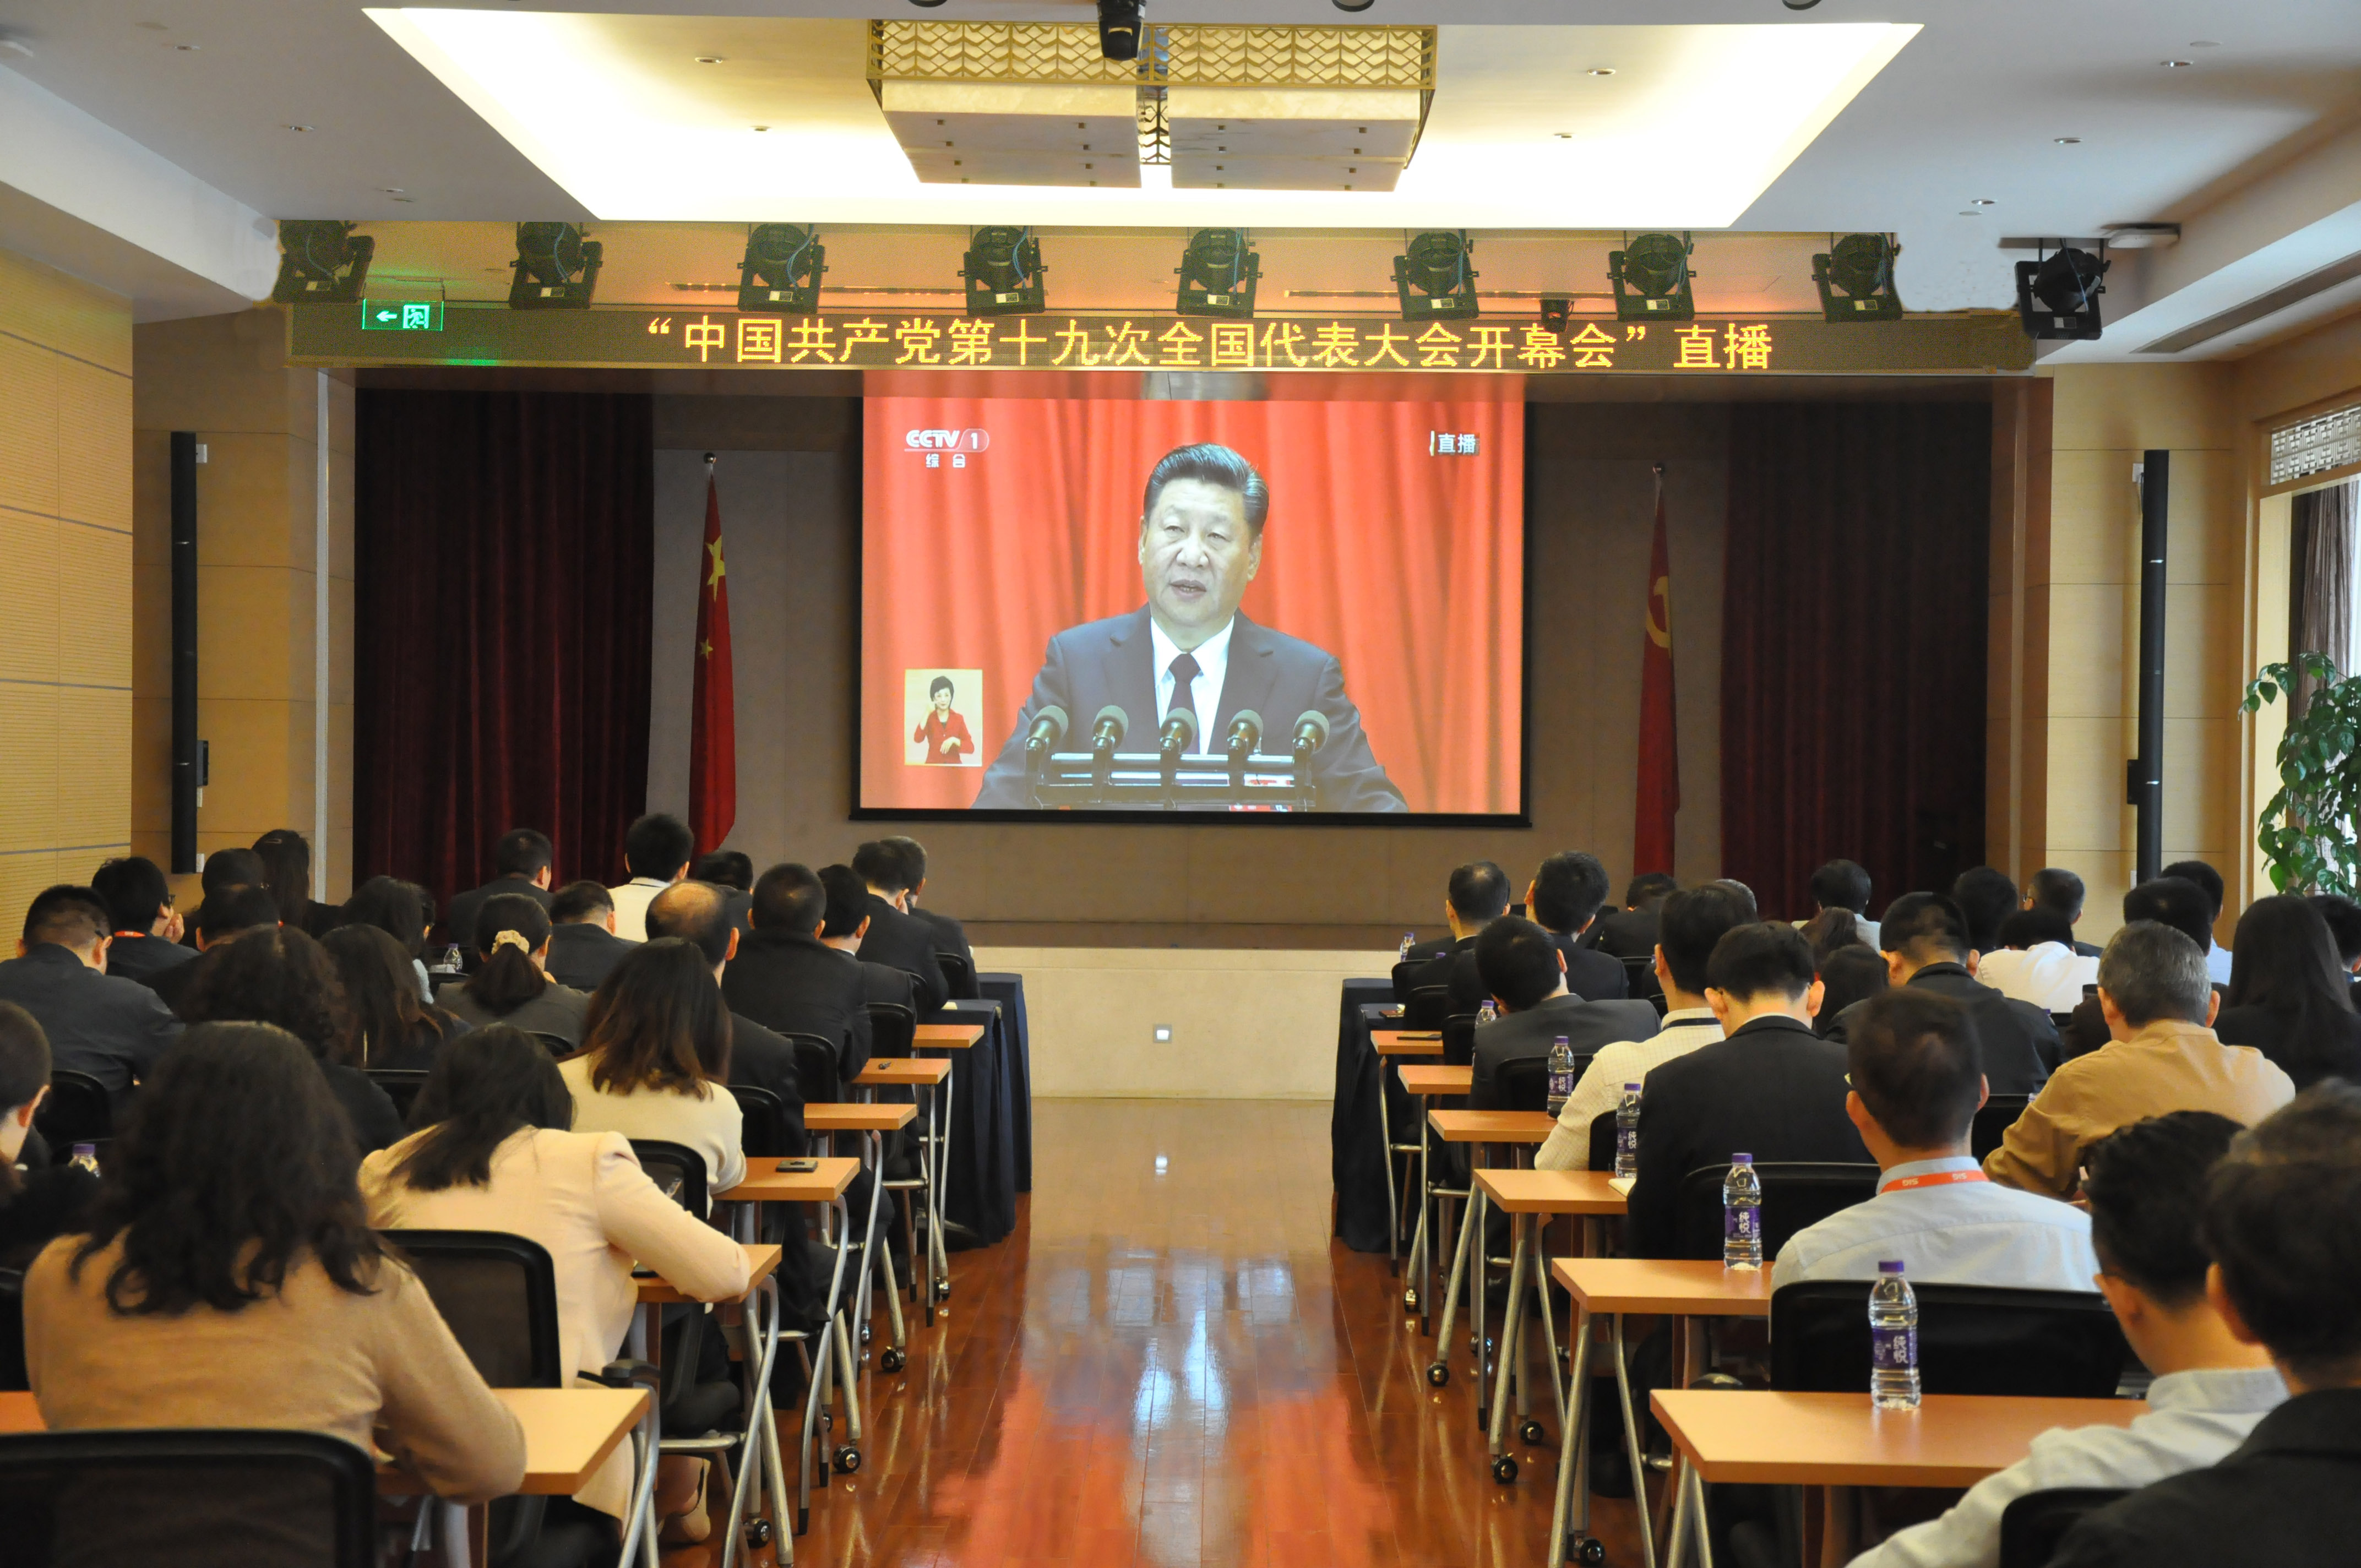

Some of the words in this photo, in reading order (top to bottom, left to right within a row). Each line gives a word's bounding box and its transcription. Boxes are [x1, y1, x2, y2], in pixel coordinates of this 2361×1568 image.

[906, 429, 960, 448] CCTV
[1438, 433, 1476, 455] 直播
[926, 453, 966, 468] 综合
[1739, 1211, 1751, 1234] 纯悦
[1893, 1336, 1908, 1364] 纯悦
